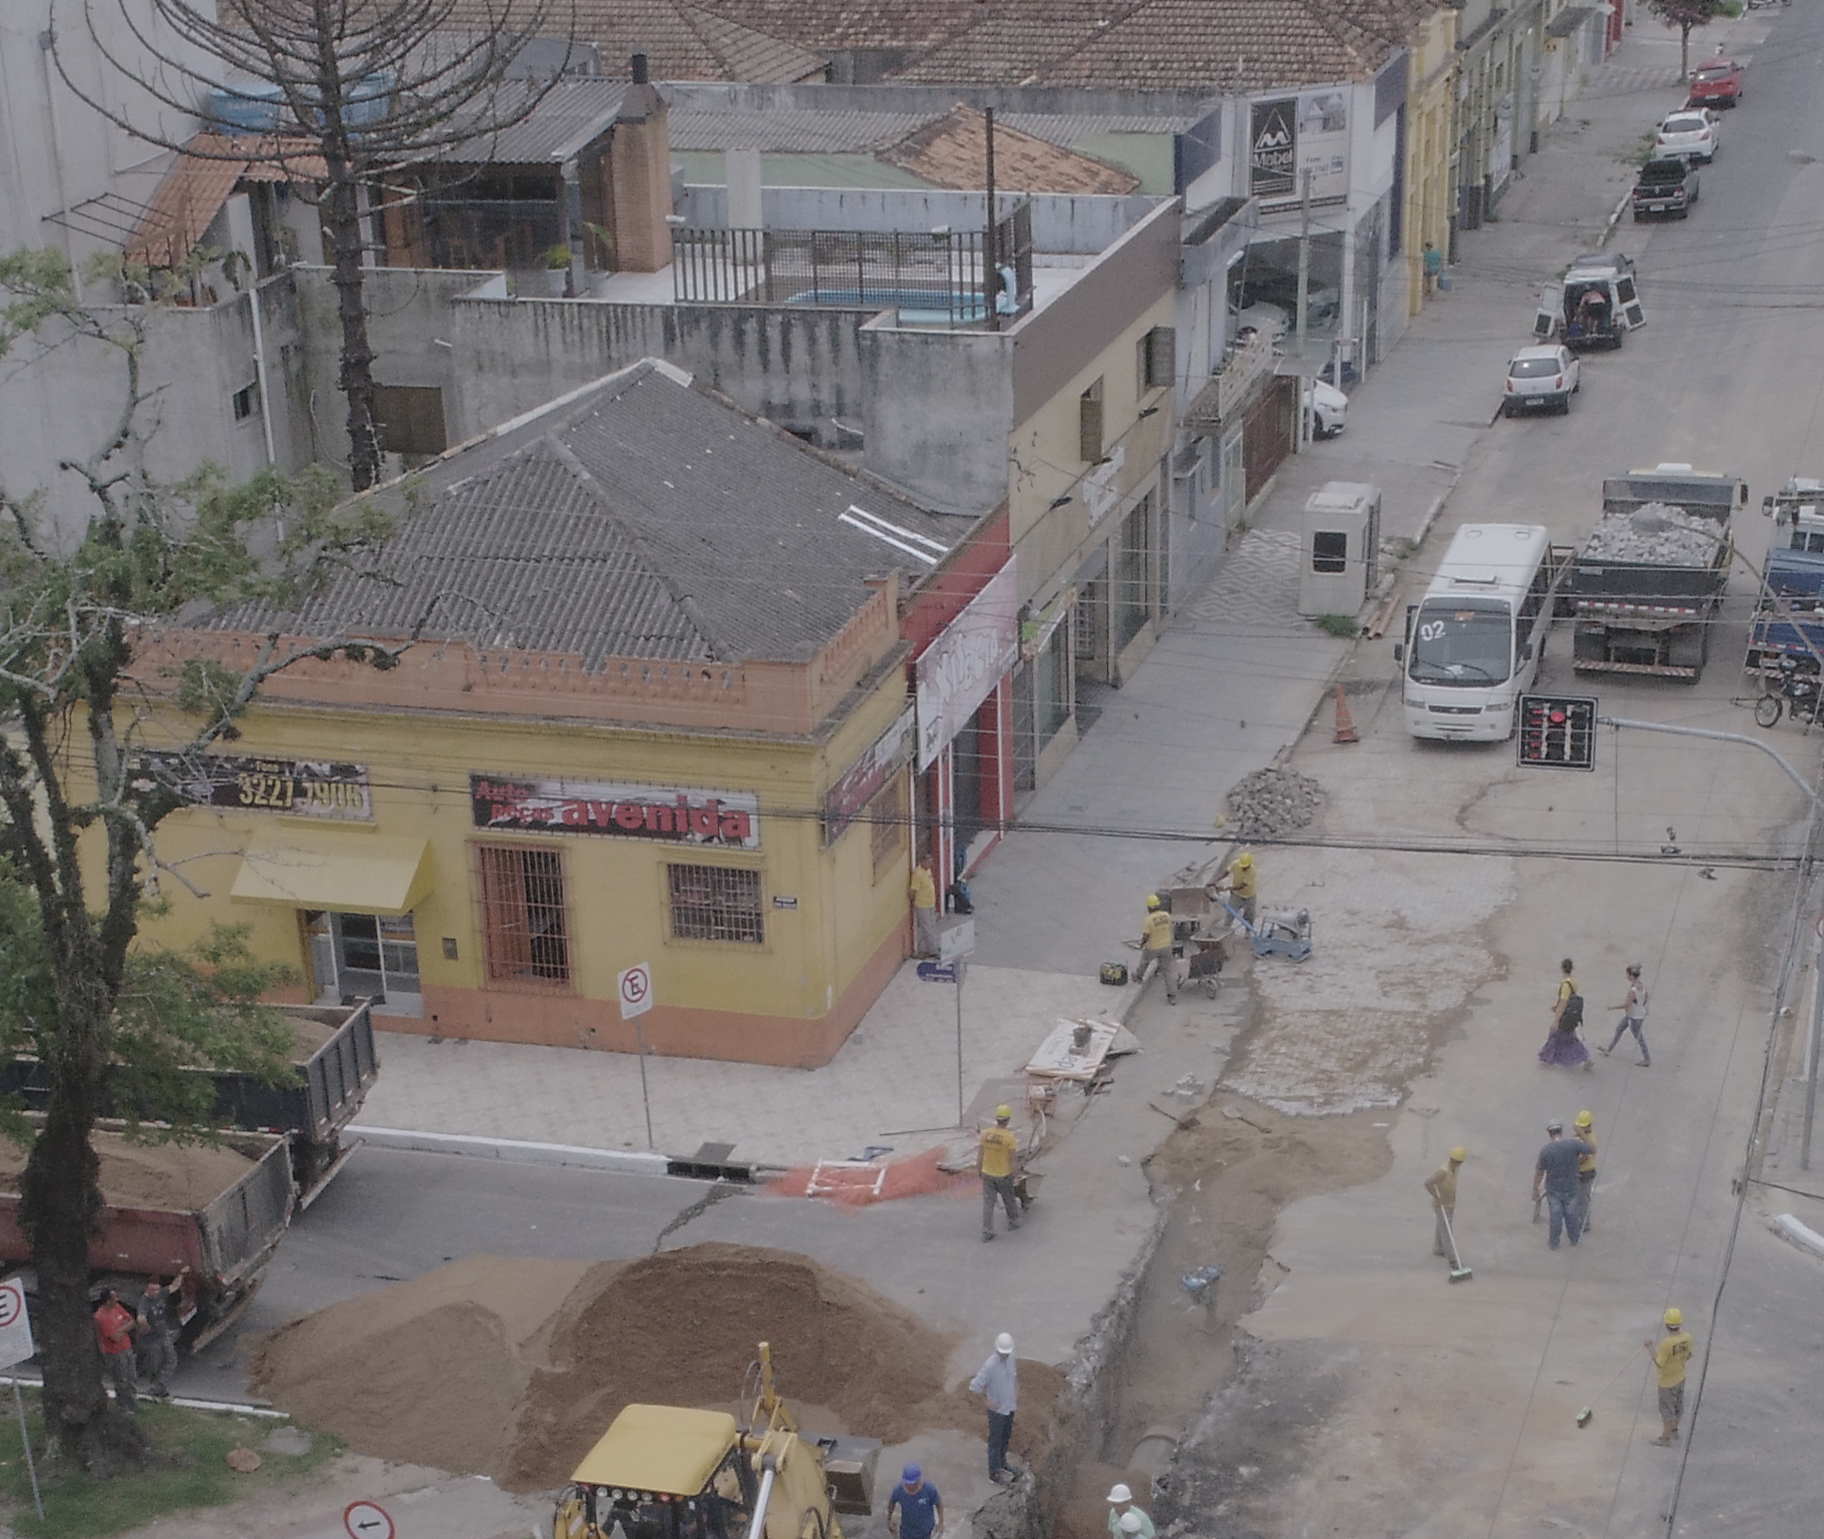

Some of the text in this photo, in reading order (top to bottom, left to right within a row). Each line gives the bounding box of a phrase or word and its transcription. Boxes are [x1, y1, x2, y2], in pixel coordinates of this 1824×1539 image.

[1421, 620, 1446, 642] 02
[475, 780, 530, 803] Auto
[561, 793, 753, 841] avenida
